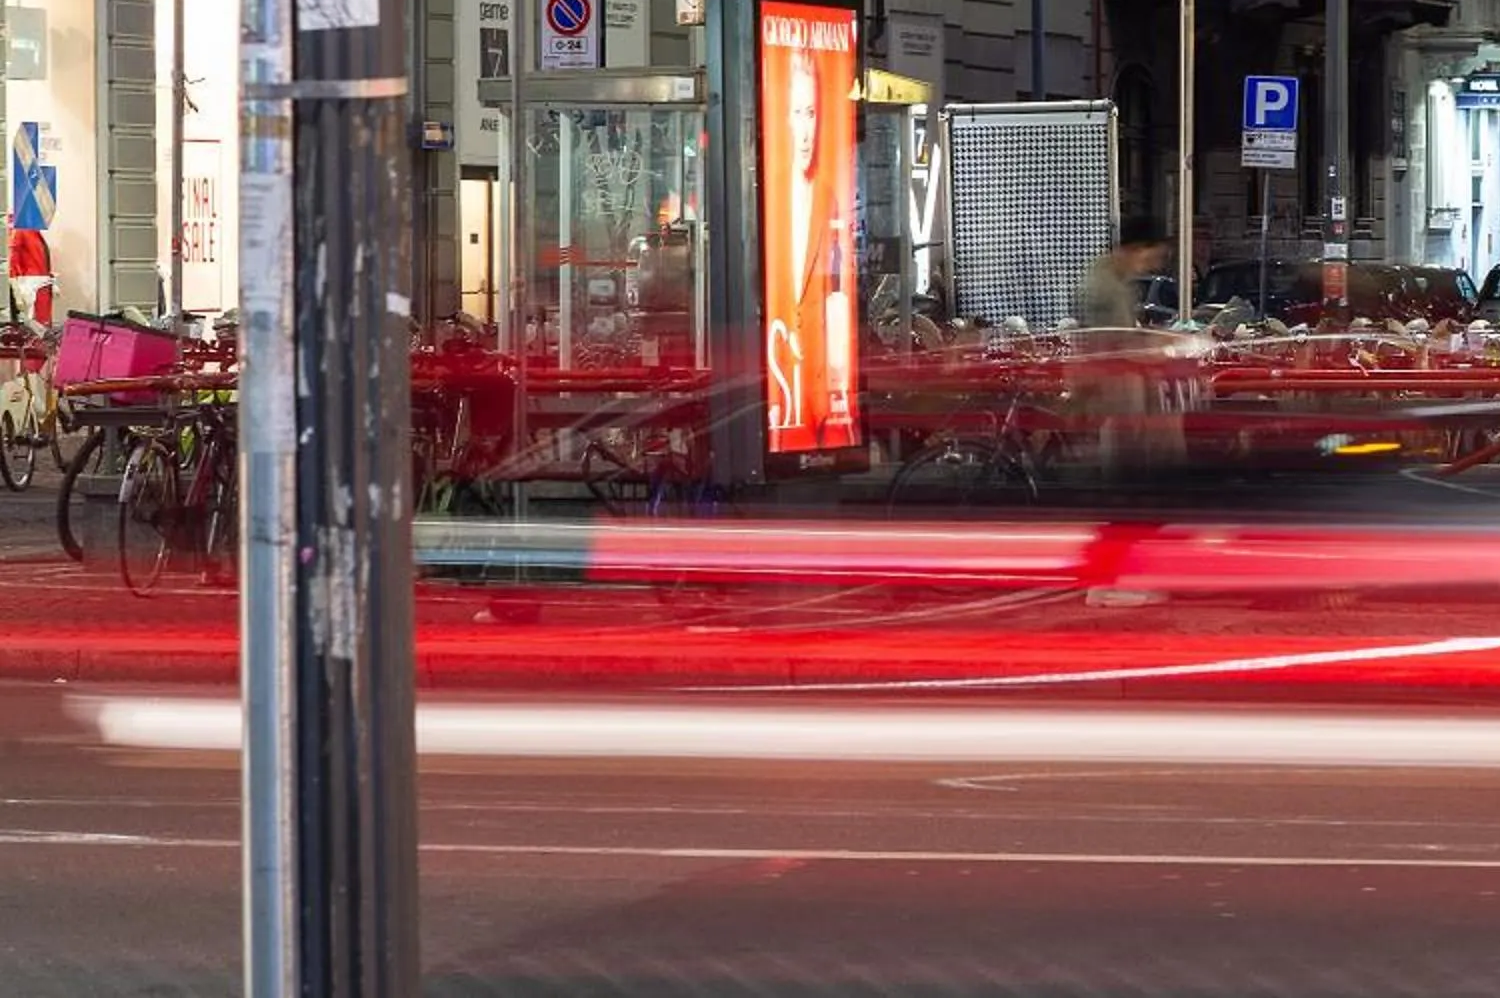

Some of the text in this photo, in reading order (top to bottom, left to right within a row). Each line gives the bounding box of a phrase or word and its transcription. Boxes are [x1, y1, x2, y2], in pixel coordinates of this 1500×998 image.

[809, 20, 849, 52] ARMANI
[1255, 81, 1289, 124] P
[181, 177, 217, 219] INAL
[181, 220, 216, 263] SALE
